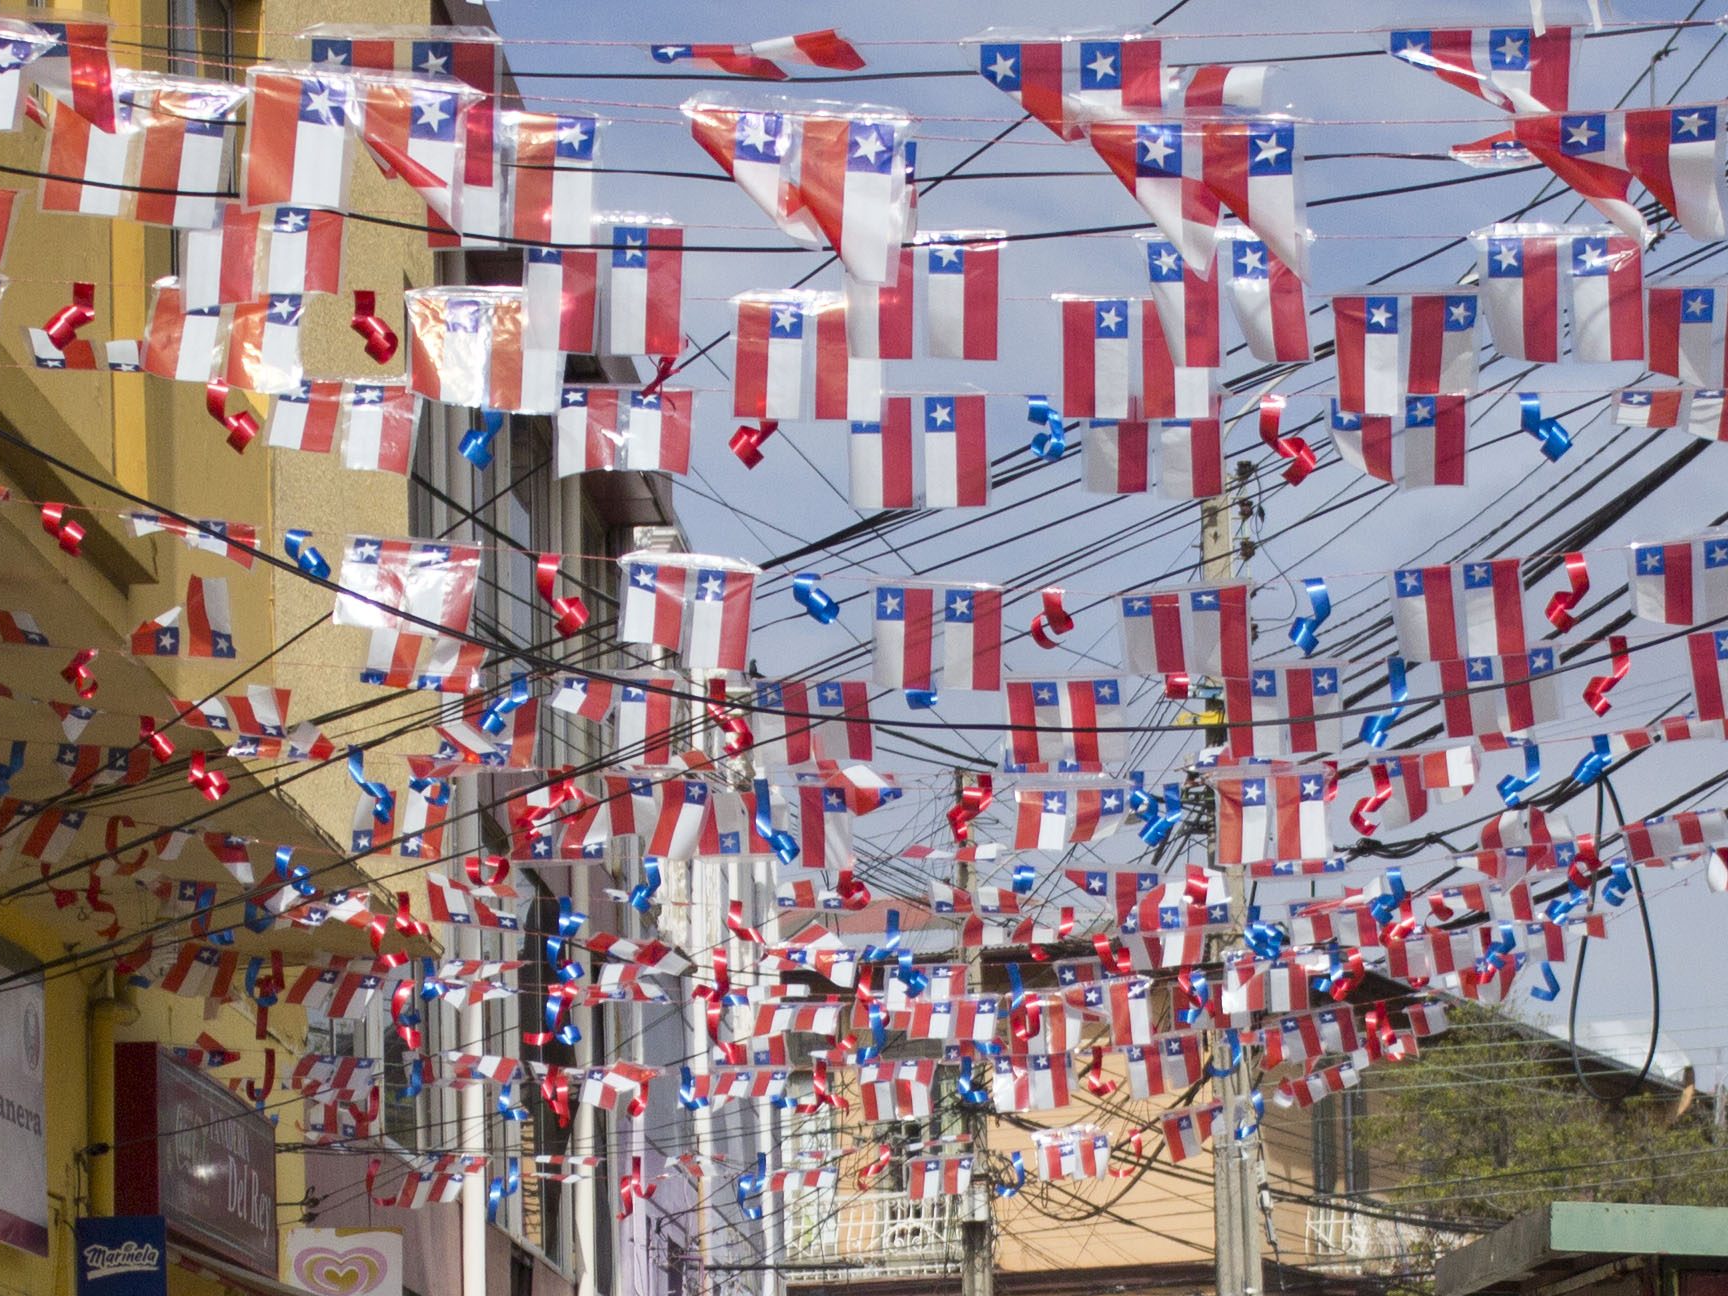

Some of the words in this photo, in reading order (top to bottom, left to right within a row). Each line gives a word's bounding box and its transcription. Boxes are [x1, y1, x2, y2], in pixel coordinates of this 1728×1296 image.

[228, 1154, 248, 1221] Del
[251, 1168, 272, 1249] Rey
[84, 1240, 160, 1270] Marinela
